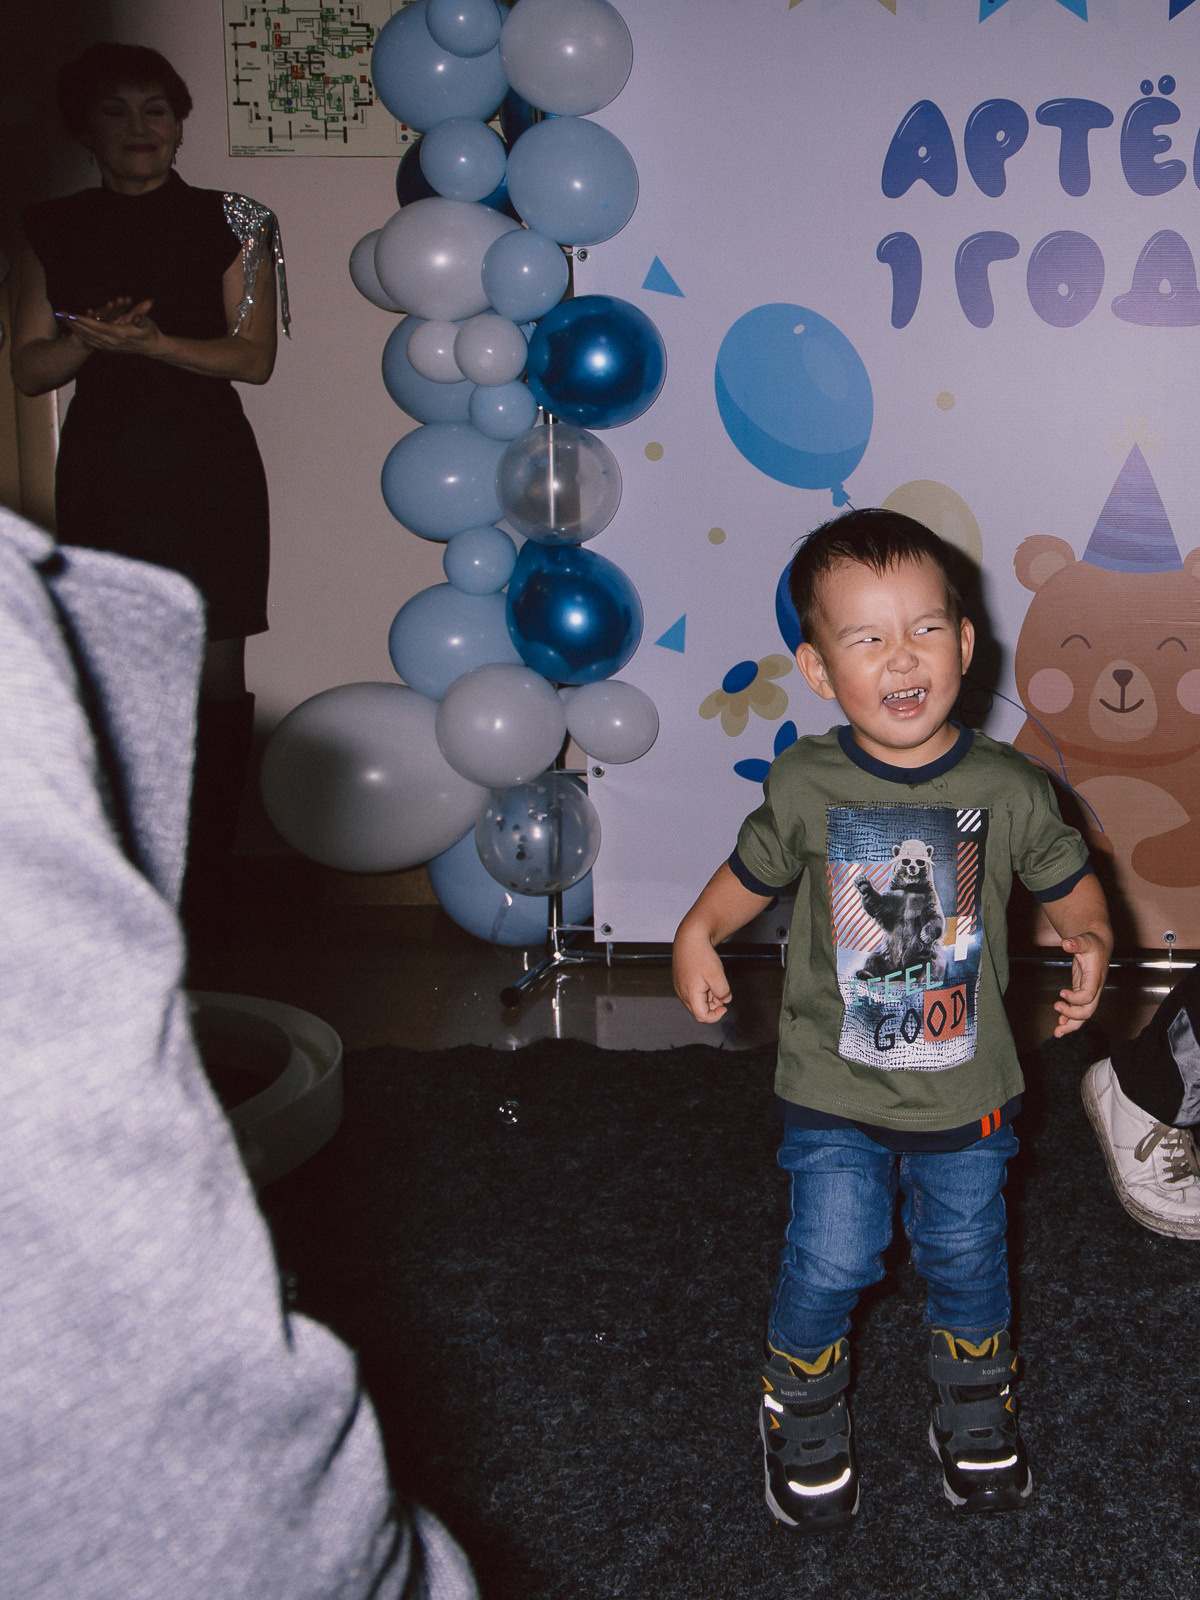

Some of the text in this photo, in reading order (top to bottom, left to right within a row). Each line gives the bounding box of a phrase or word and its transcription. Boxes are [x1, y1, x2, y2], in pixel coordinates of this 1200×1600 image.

[876, 231, 922, 329] 1
[867, 961, 943, 1005] FEEL
[874, 989, 966, 1052] GOOD
[780, 1388, 808, 1397] kapika
